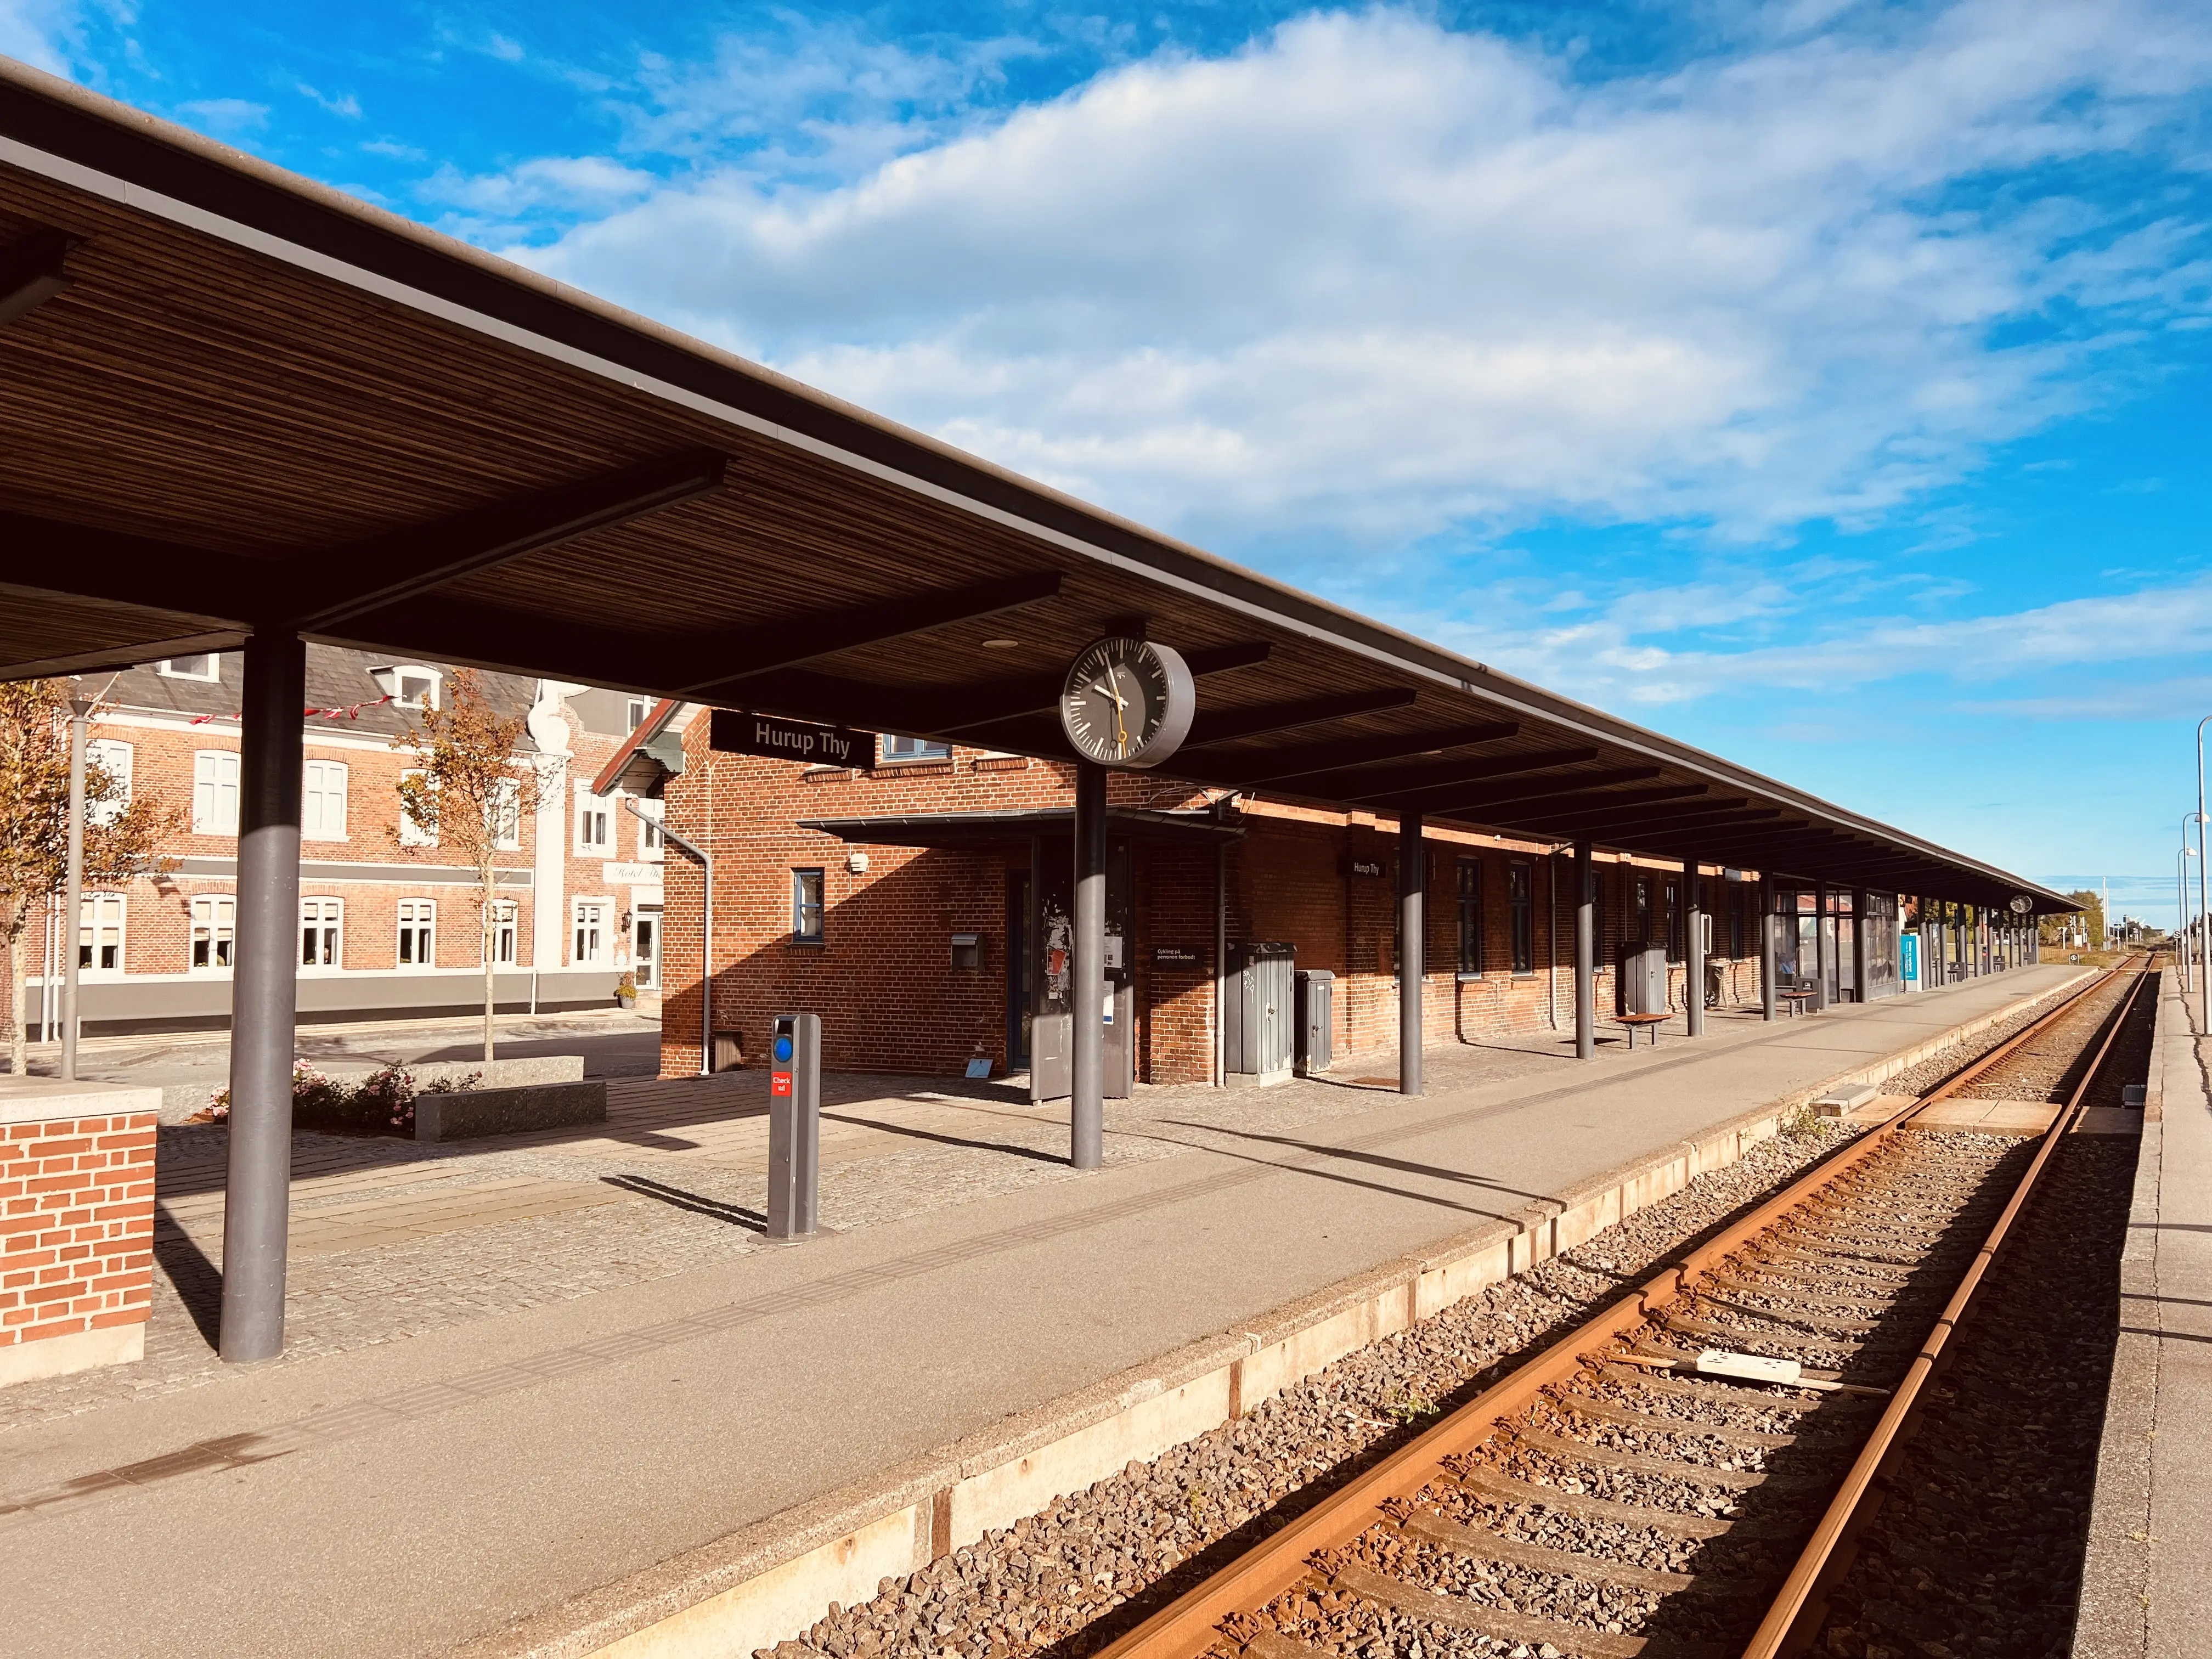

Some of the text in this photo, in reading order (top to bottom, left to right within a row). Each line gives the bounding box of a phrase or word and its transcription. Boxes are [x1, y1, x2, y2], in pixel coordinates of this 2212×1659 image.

[756, 723, 850, 759] Hurup Thy
[614, 866, 644, 877] Hotel
[1354, 862, 1379, 876] Hurup Thy
